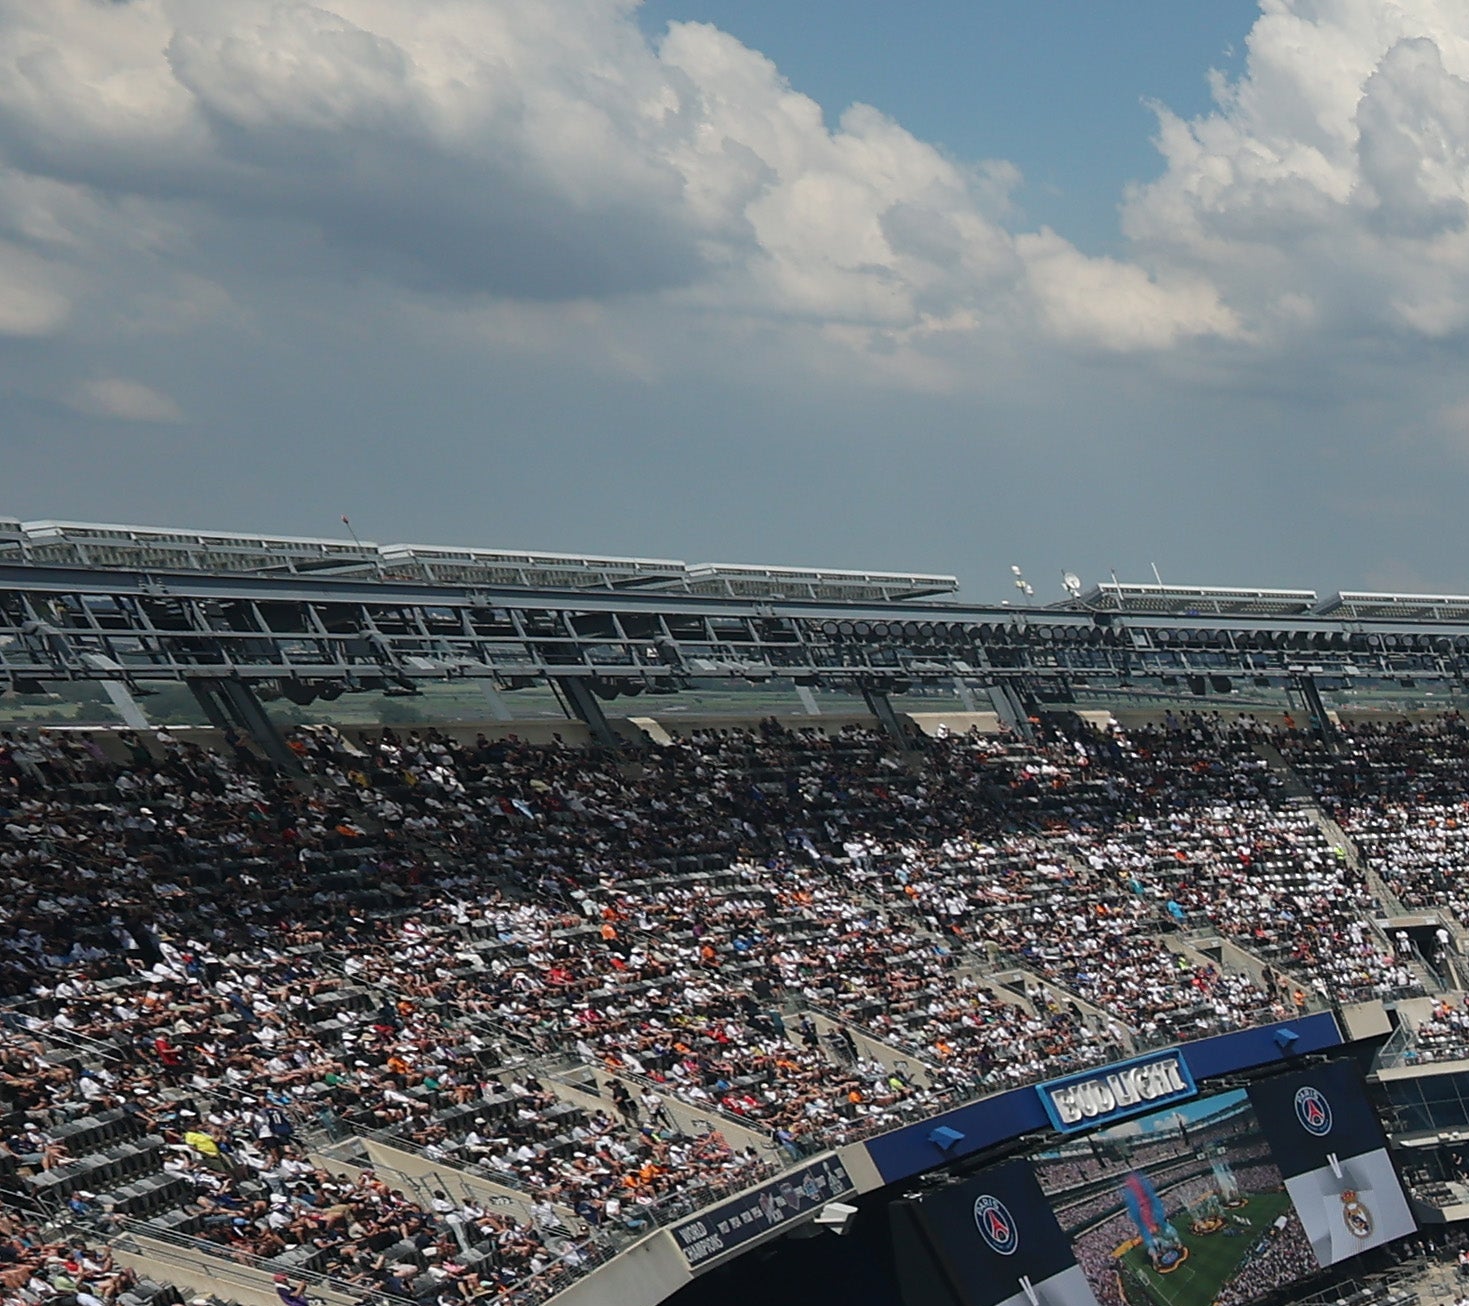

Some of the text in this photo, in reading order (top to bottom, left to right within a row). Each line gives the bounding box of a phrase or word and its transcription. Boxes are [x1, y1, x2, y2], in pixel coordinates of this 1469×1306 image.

[1052, 1060, 1188, 1125] BUD LIGHT
[679, 1221, 708, 1244] WORLD
[683, 1233, 724, 1264] CHAMPIONS
